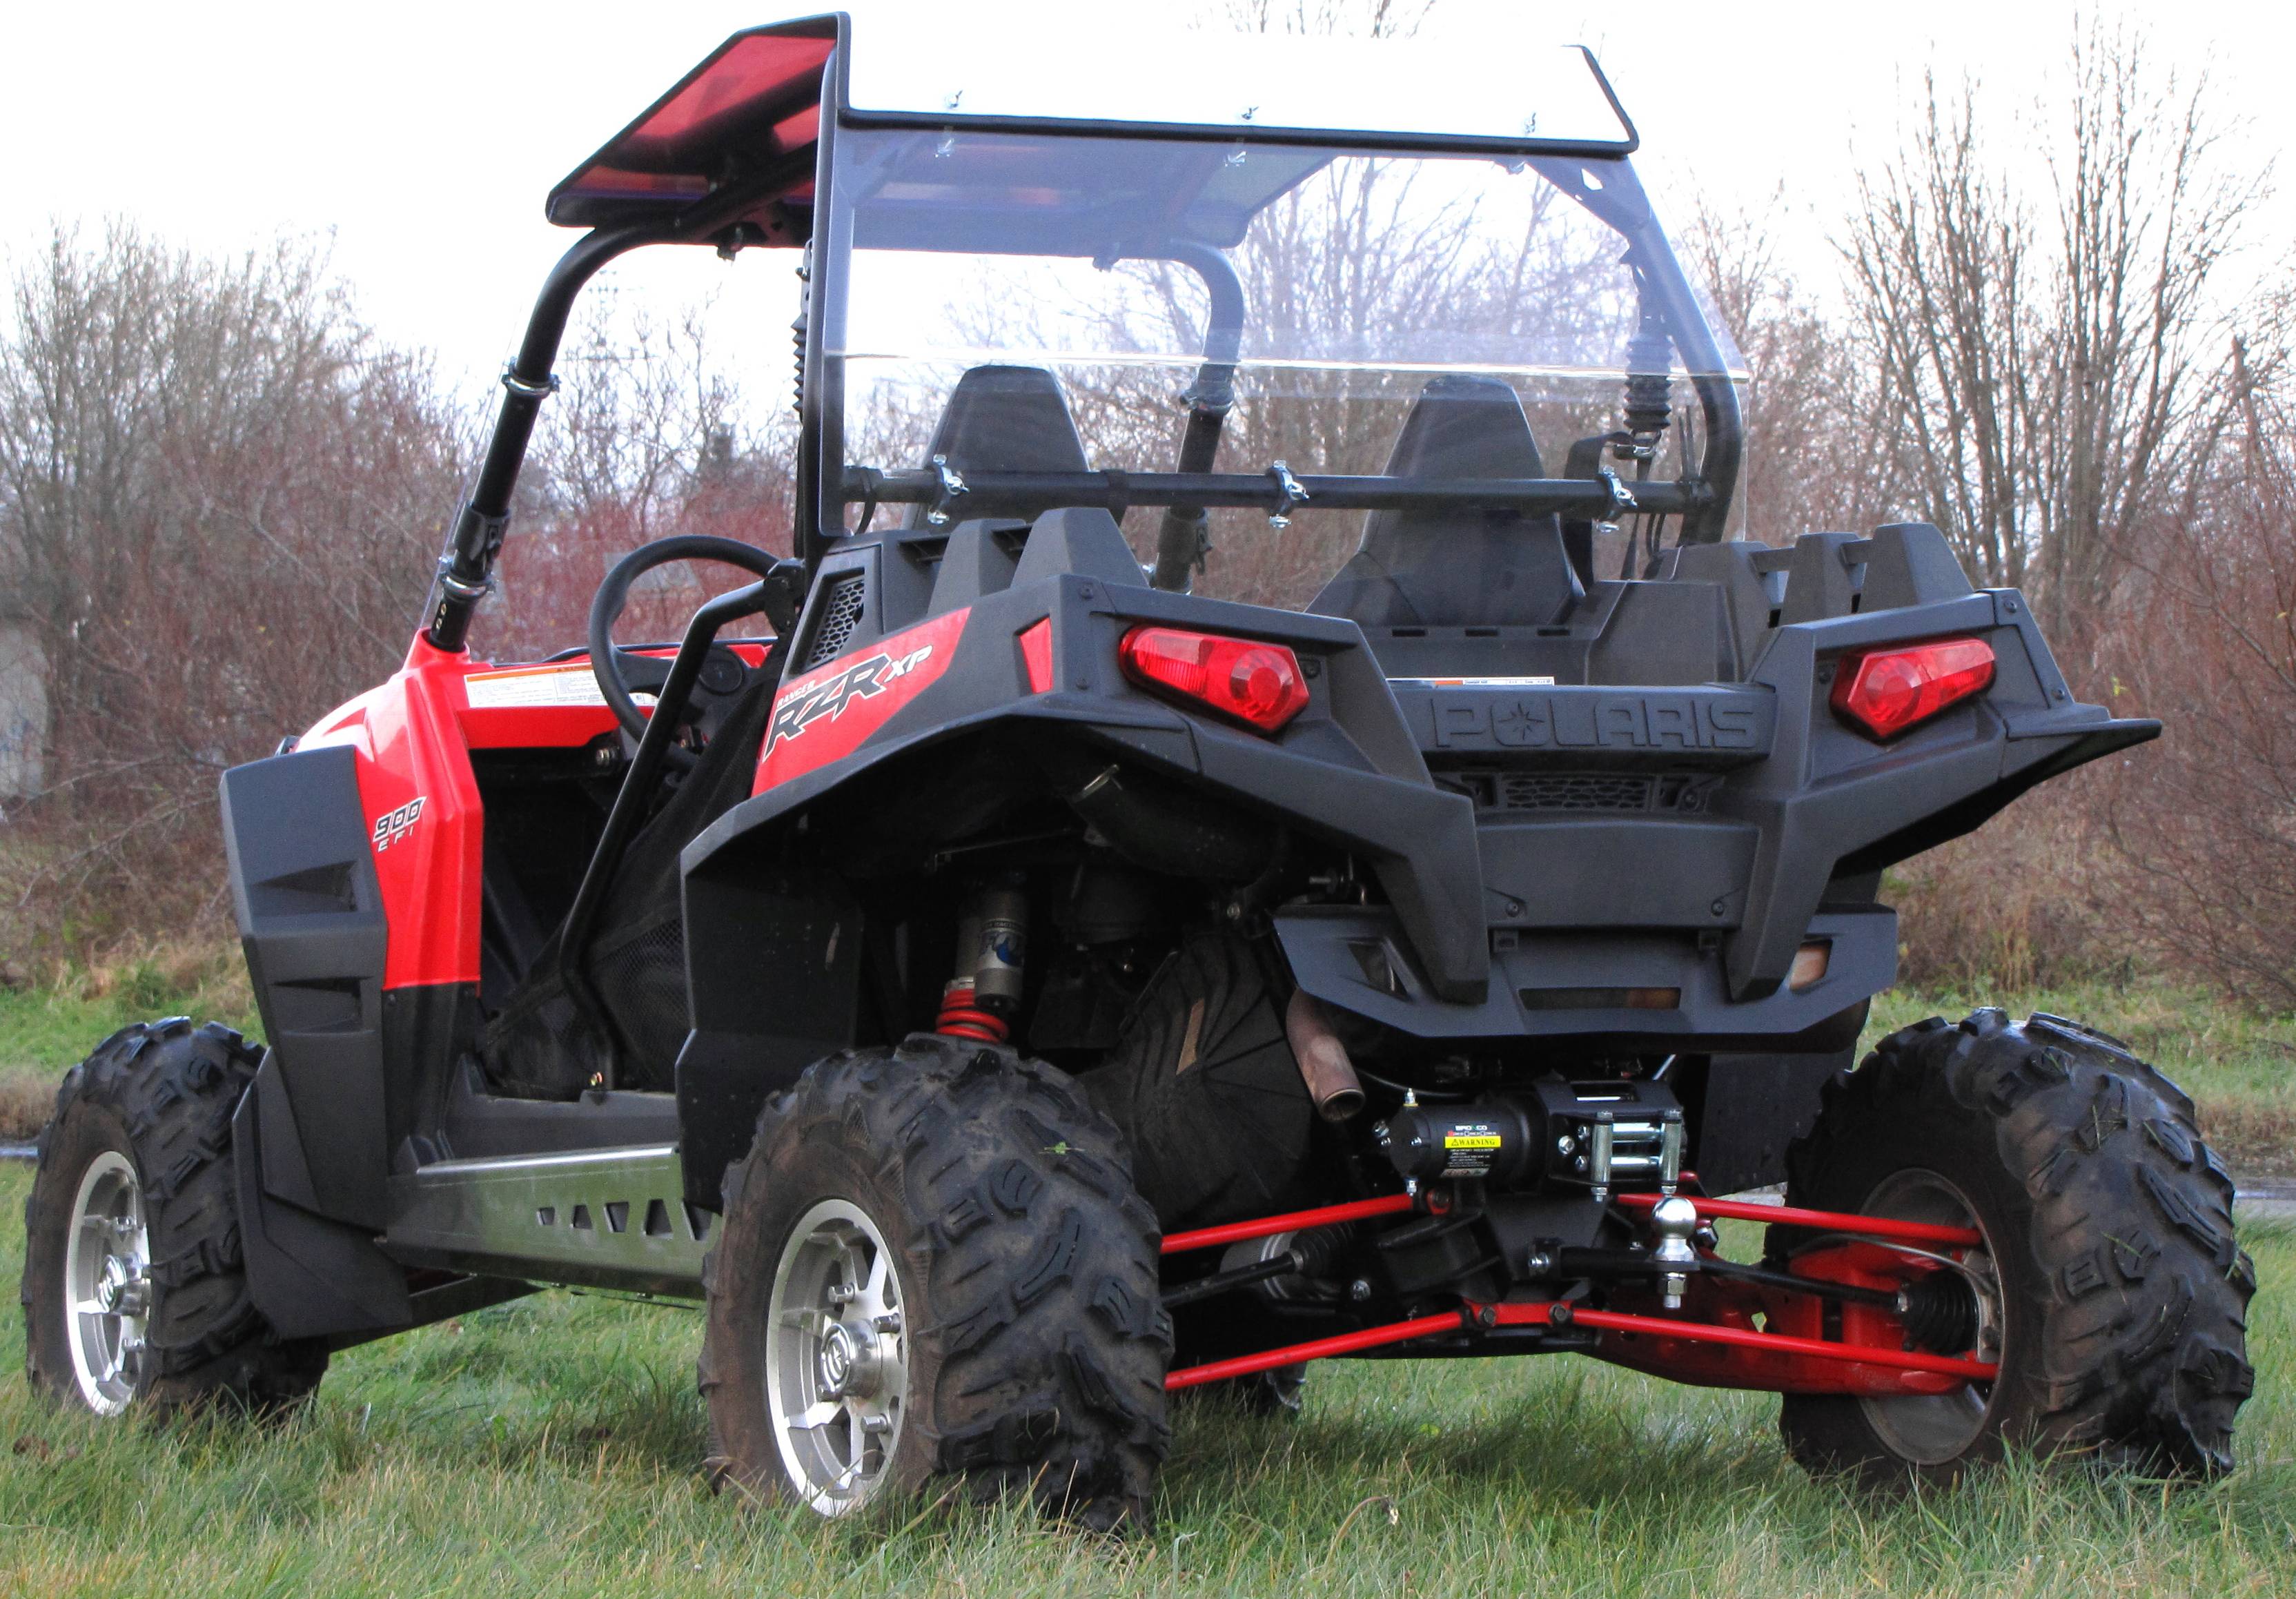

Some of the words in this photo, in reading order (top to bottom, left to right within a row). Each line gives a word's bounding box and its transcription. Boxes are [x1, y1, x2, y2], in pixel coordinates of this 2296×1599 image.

[761, 652, 892, 763] RZR
[884, 645, 934, 683] XP
[1431, 697, 1759, 748] POLARIS
[373, 795, 428, 843] 900
[377, 825, 414, 854] EFI
